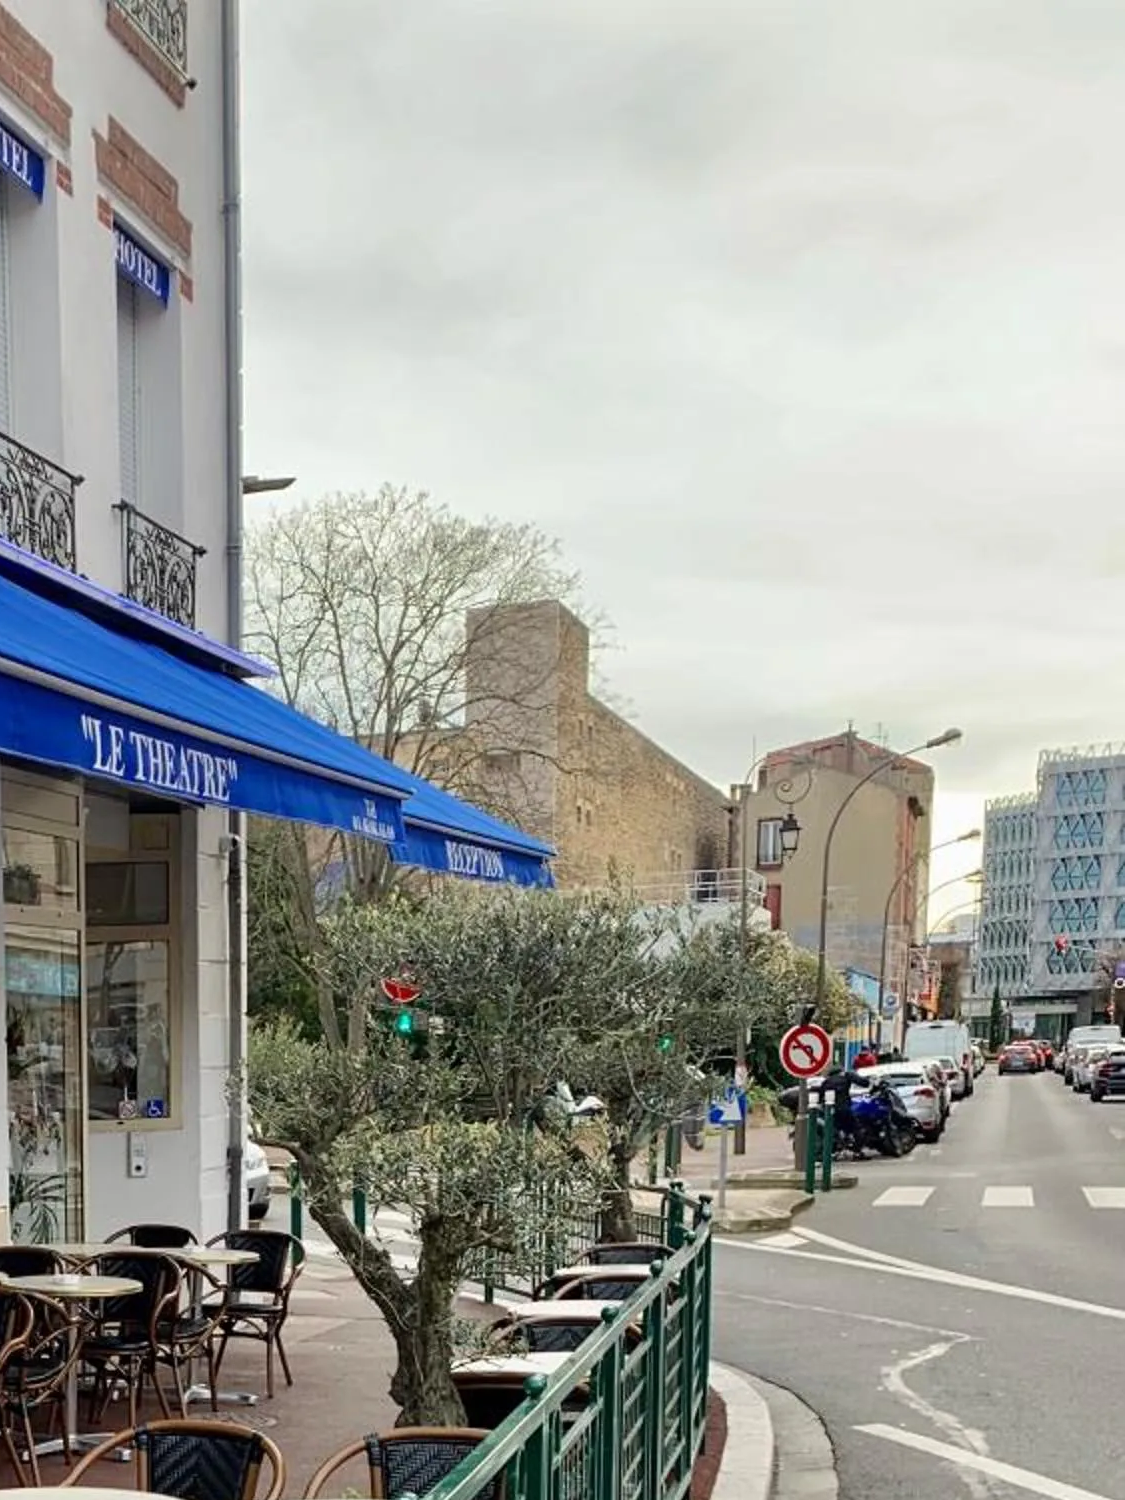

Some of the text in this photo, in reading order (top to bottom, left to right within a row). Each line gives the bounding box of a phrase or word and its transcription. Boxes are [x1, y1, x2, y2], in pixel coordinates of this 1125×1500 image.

[114, 230, 162, 297] HOTEL
[80, 713, 238, 802] "LE THEATRE"
